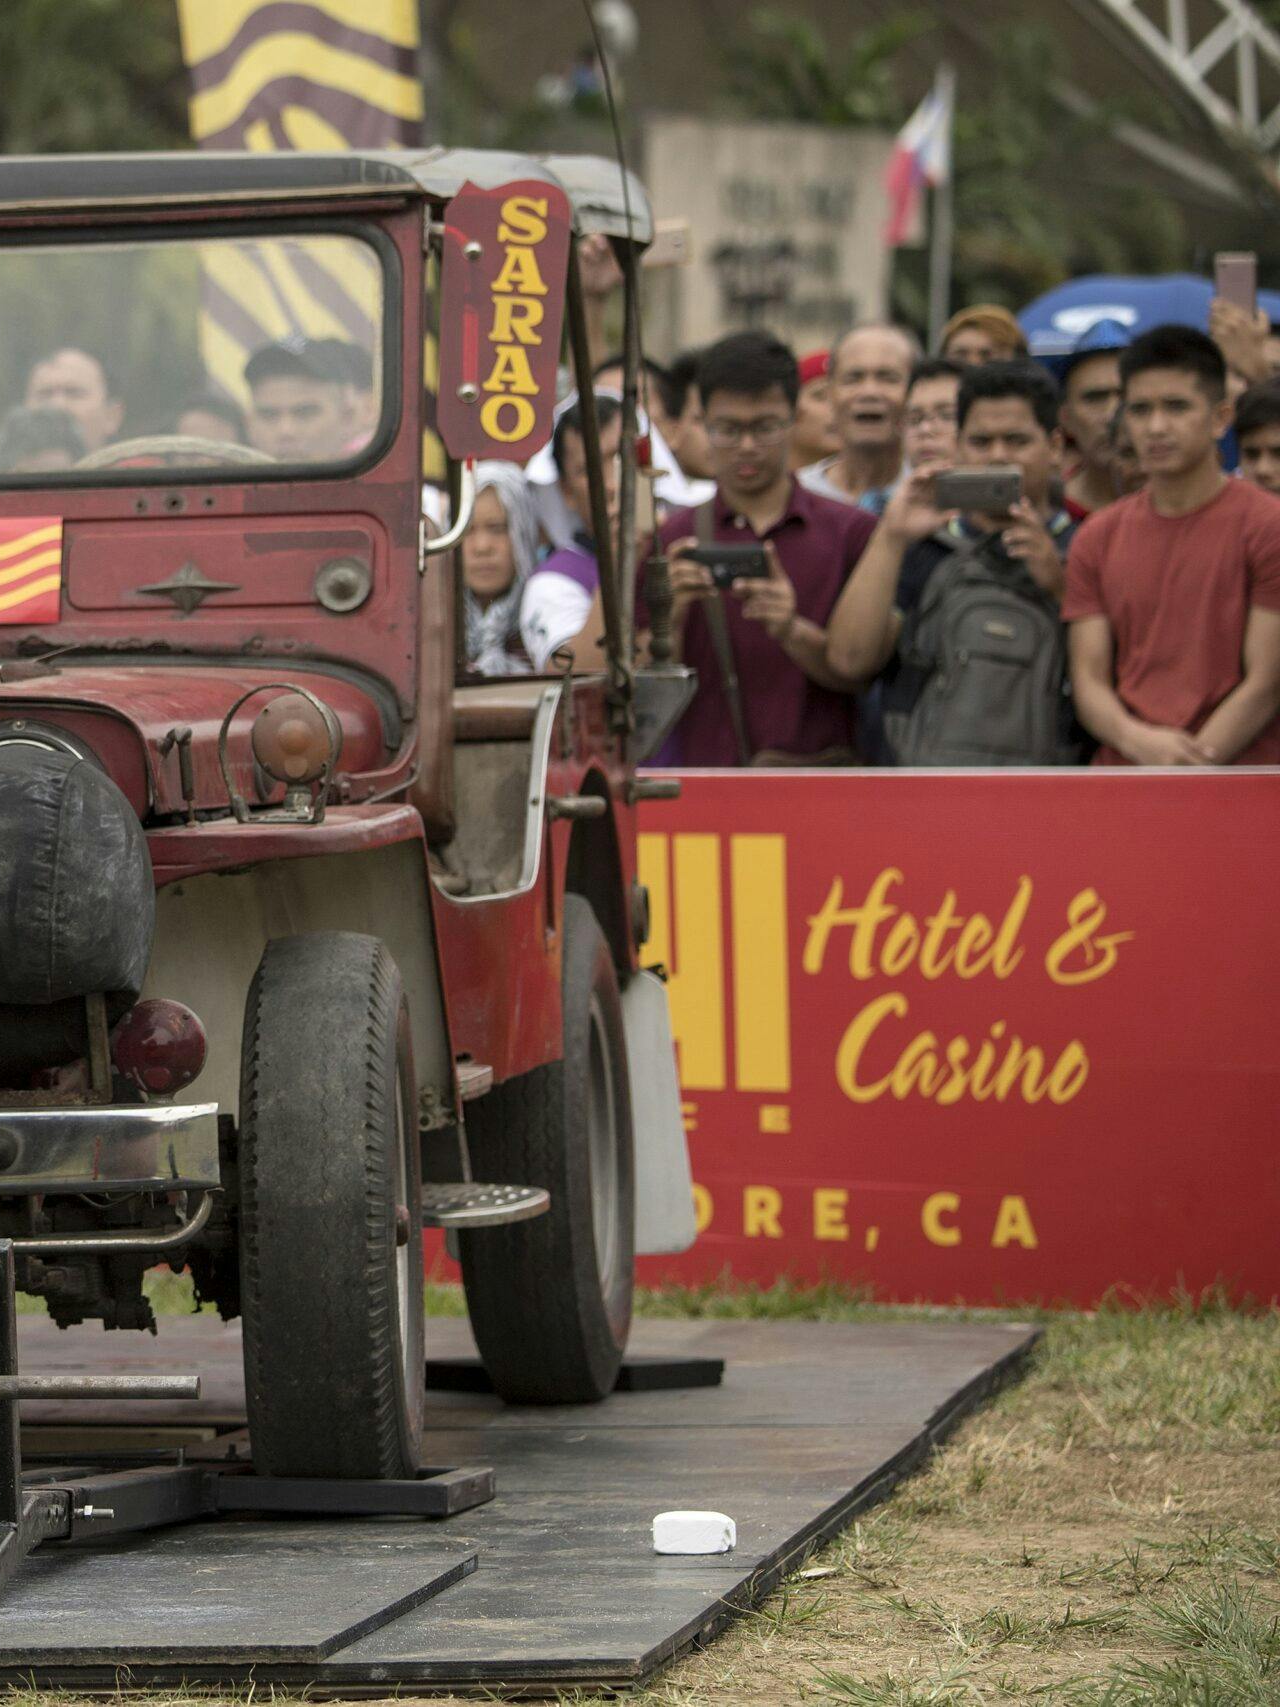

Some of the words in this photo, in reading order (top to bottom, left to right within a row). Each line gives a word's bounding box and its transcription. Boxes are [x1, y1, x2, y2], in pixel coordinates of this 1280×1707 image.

[480, 196, 549, 443] SARAO
[803, 867, 1033, 980] Hotel
[1044, 886, 1136, 986] &
[835, 991, 1089, 1105] Casino
[921, 1191, 1039, 1250] CA
